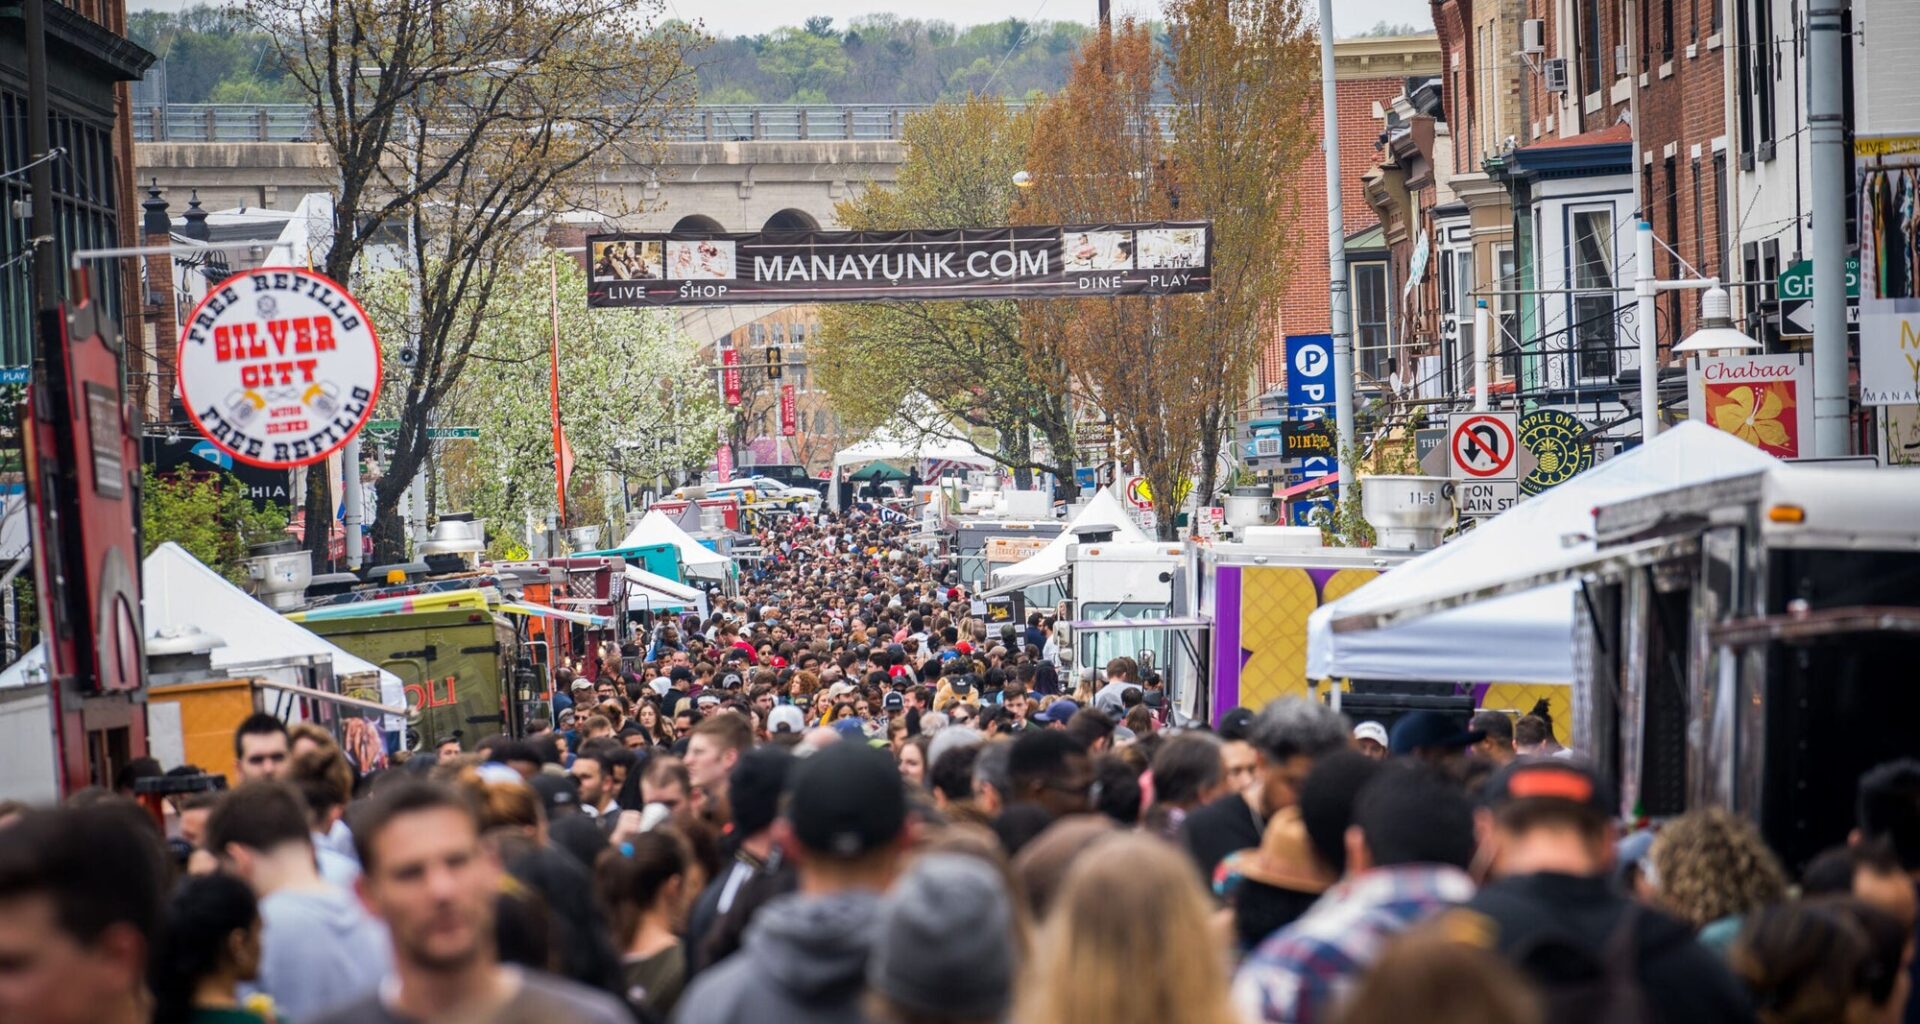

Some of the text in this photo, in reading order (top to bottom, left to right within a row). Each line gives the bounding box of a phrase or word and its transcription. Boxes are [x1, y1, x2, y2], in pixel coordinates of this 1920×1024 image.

[754, 249, 1049, 282] MANAYUNK.COM
[608, 273, 1191, 299] LIVE SHOP DINE PLAY
[189, 273, 360, 345] FREE REFILLS
[214, 315, 337, 363] SILVER
[3, 372, 26, 381] PLAY
[241, 359, 318, 388] CITY
[731, 351, 739, 390] MANAUNK
[1704, 361, 1796, 380] Chabaa
[1866, 391, 1920, 401] MANA
[200, 386, 371, 462] FREE REFILLS
[1519, 412, 1592, 453] APPLE ON MN
[1288, 435, 1330, 449] DINER
[239, 485, 286, 499] PHIA
[1410, 491, 1435, 505] 11-6
[1472, 485, 1493, 497] ON
[1467, 498, 1515, 511] AIN ST
